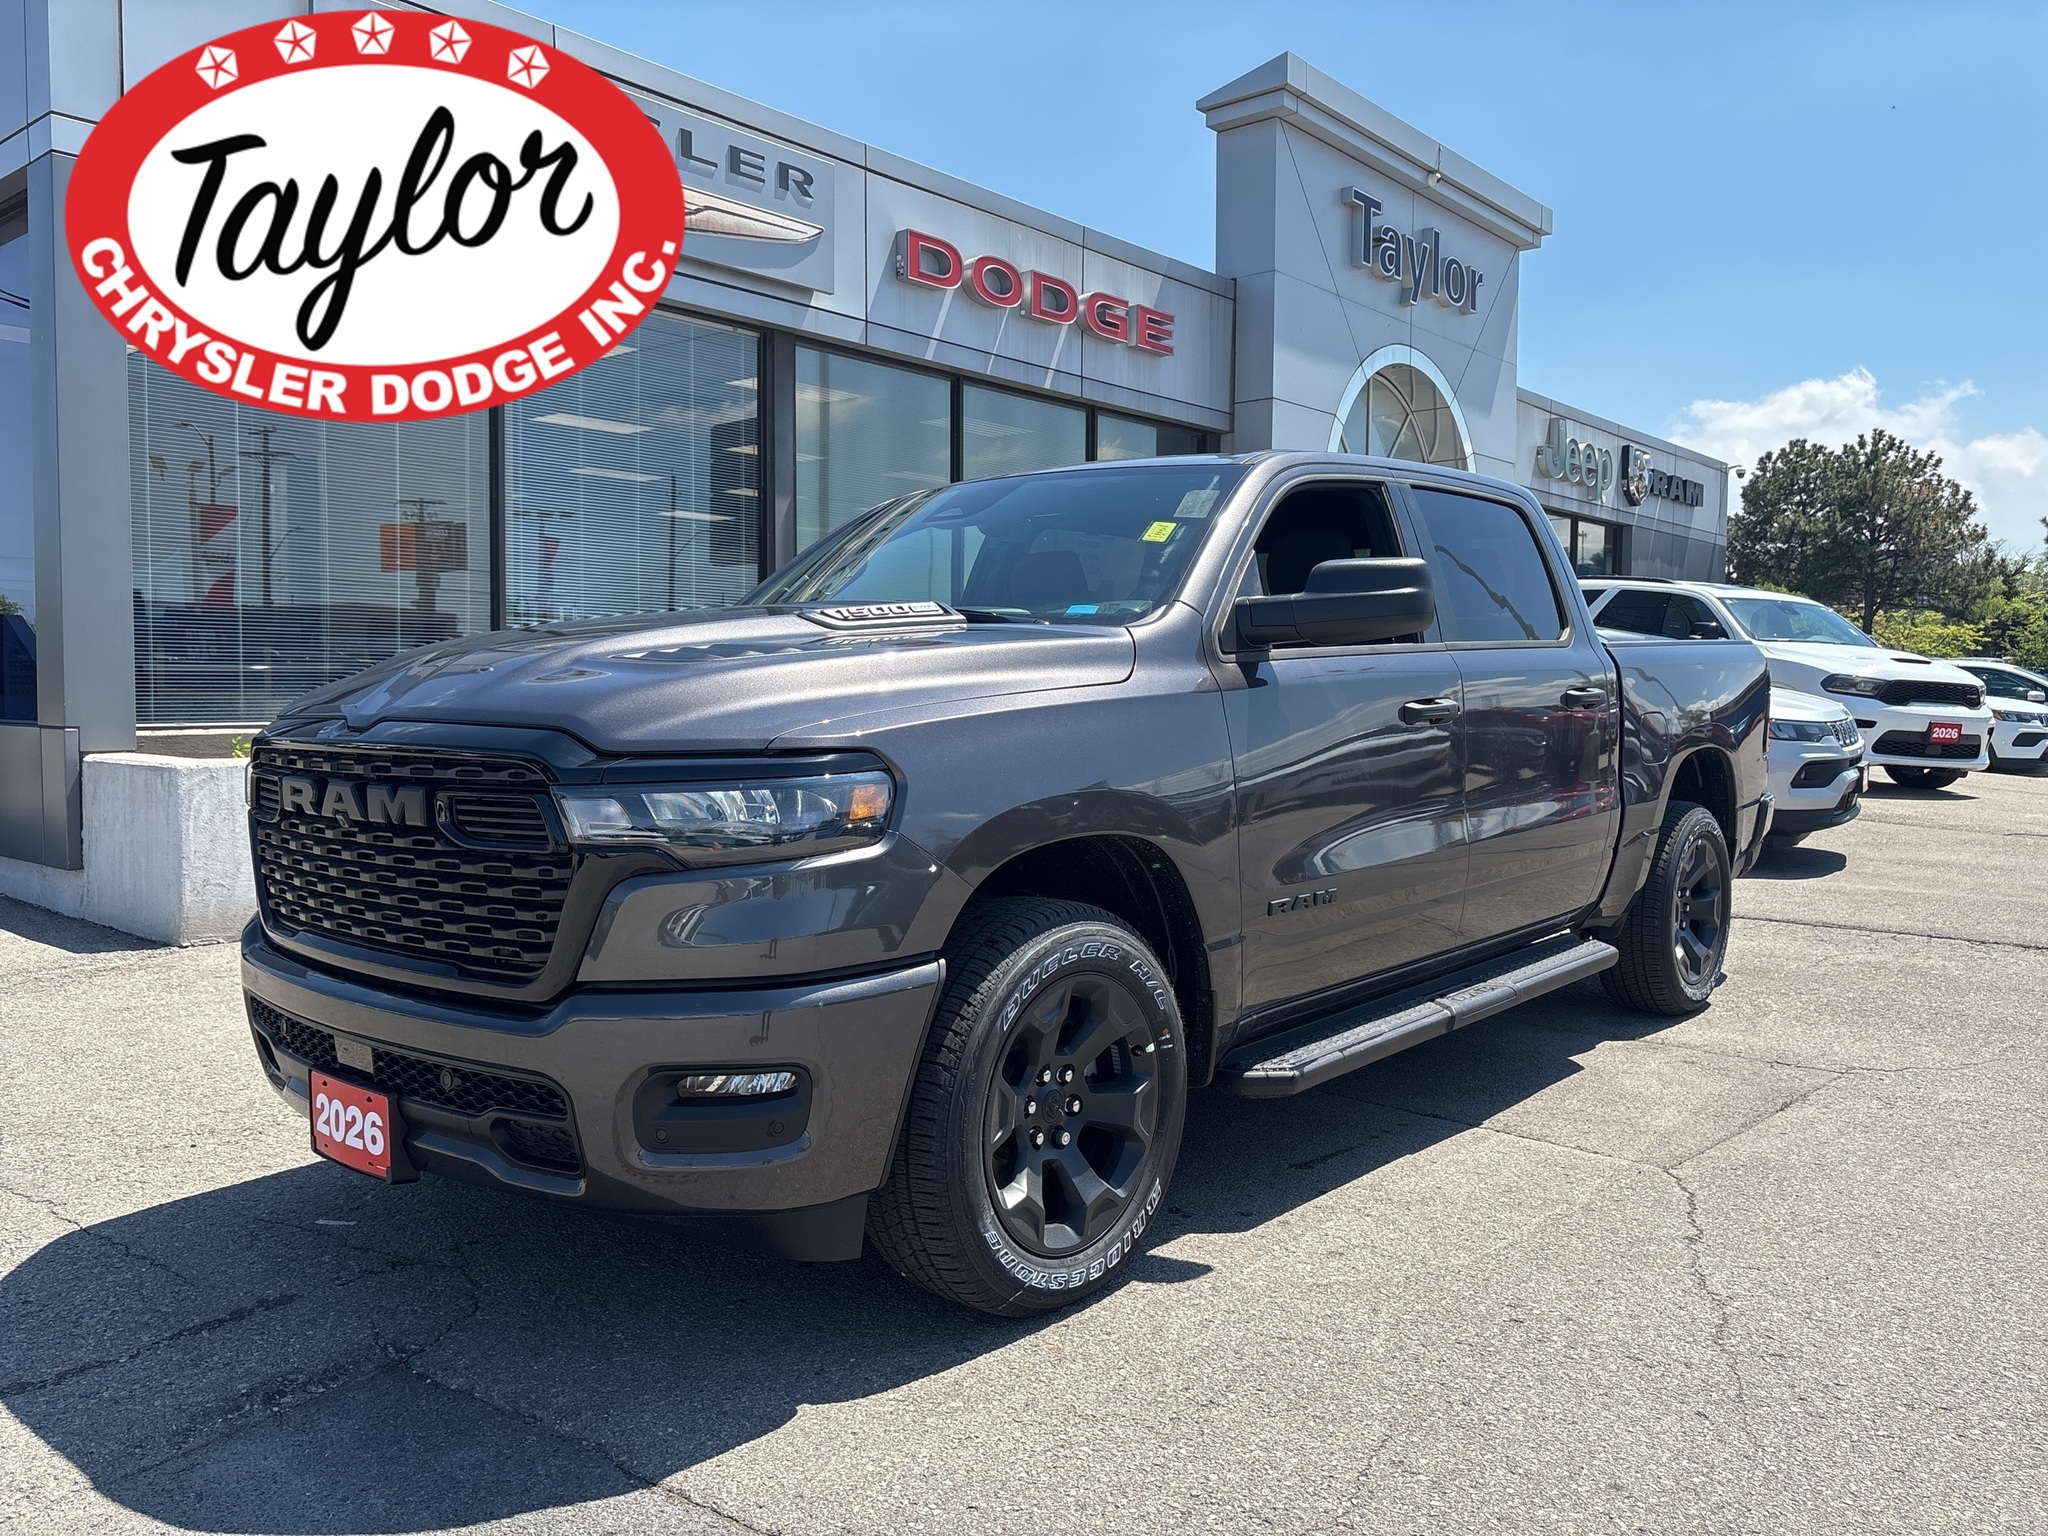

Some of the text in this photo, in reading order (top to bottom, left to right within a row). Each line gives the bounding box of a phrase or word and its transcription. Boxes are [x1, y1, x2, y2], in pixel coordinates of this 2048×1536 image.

[647, 114, 815, 200] LER
[1342, 186, 1484, 315] Taylor
[897, 228, 1176, 357] DODGE
[1537, 418, 1612, 504] Jeep
[1651, 469, 1704, 507] RAM
[835, 604, 911, 620] 1500
[1931, 727, 1959, 739] 2026
[282, 775, 427, 826] RAM
[1267, 888, 1338, 917] RAM
[1002, 942, 1167, 1032] DUELER H/L
[315, 1092, 385, 1156] 2026
[984, 1177, 1162, 1290] BRIDGESTONE
